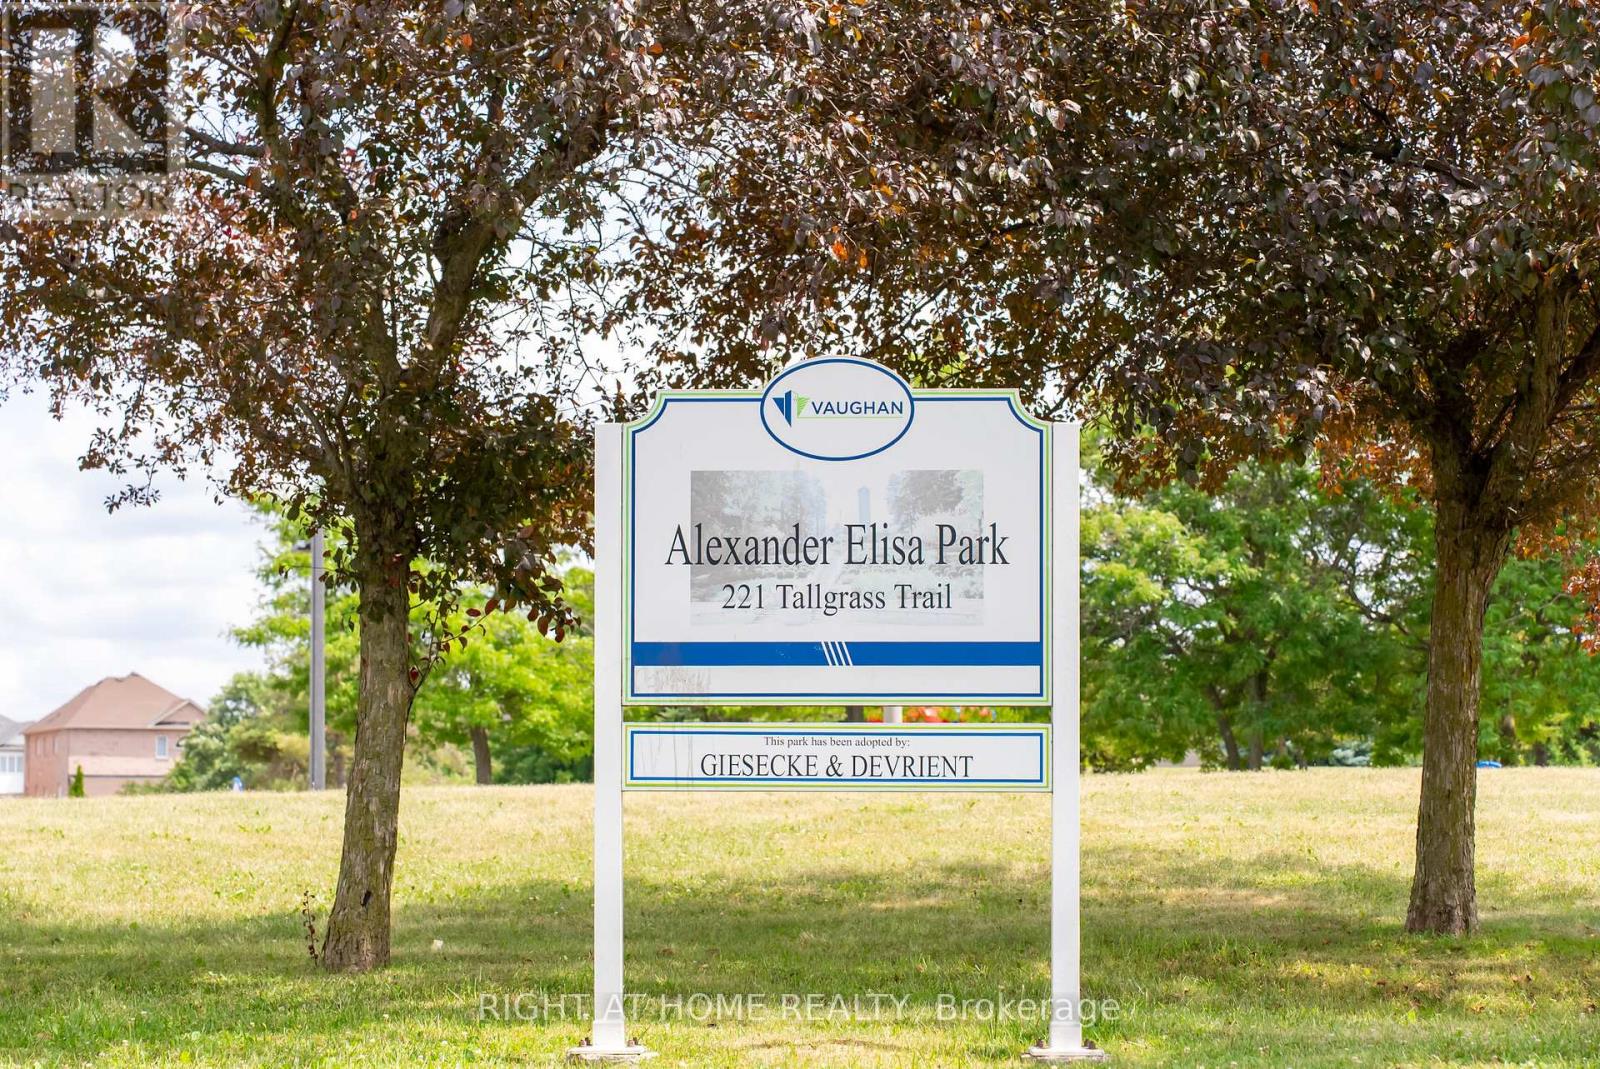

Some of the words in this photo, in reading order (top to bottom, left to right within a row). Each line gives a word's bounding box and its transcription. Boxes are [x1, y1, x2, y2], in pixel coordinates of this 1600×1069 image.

[812, 401, 903, 415] VAUGHAN
[664, 522, 834, 566] Alexander
[844, 522, 924, 566] Elisa
[935, 522, 1010, 566] Park
[722, 583, 764, 609] 221
[776, 583, 886, 617] Tallgrass
[893, 583, 952, 609] Trail
[764, 736, 785, 746] This
[787, 736, 809, 749] park
[811, 736, 828, 746] has
[829, 736, 853, 746] been
[854, 736, 893, 749] adopted
[894, 736, 910, 749] by:
[700, 753, 818, 777] GIESECKE
[825, 754, 844, 778] &
[851, 754, 974, 778] DEVRIENT
